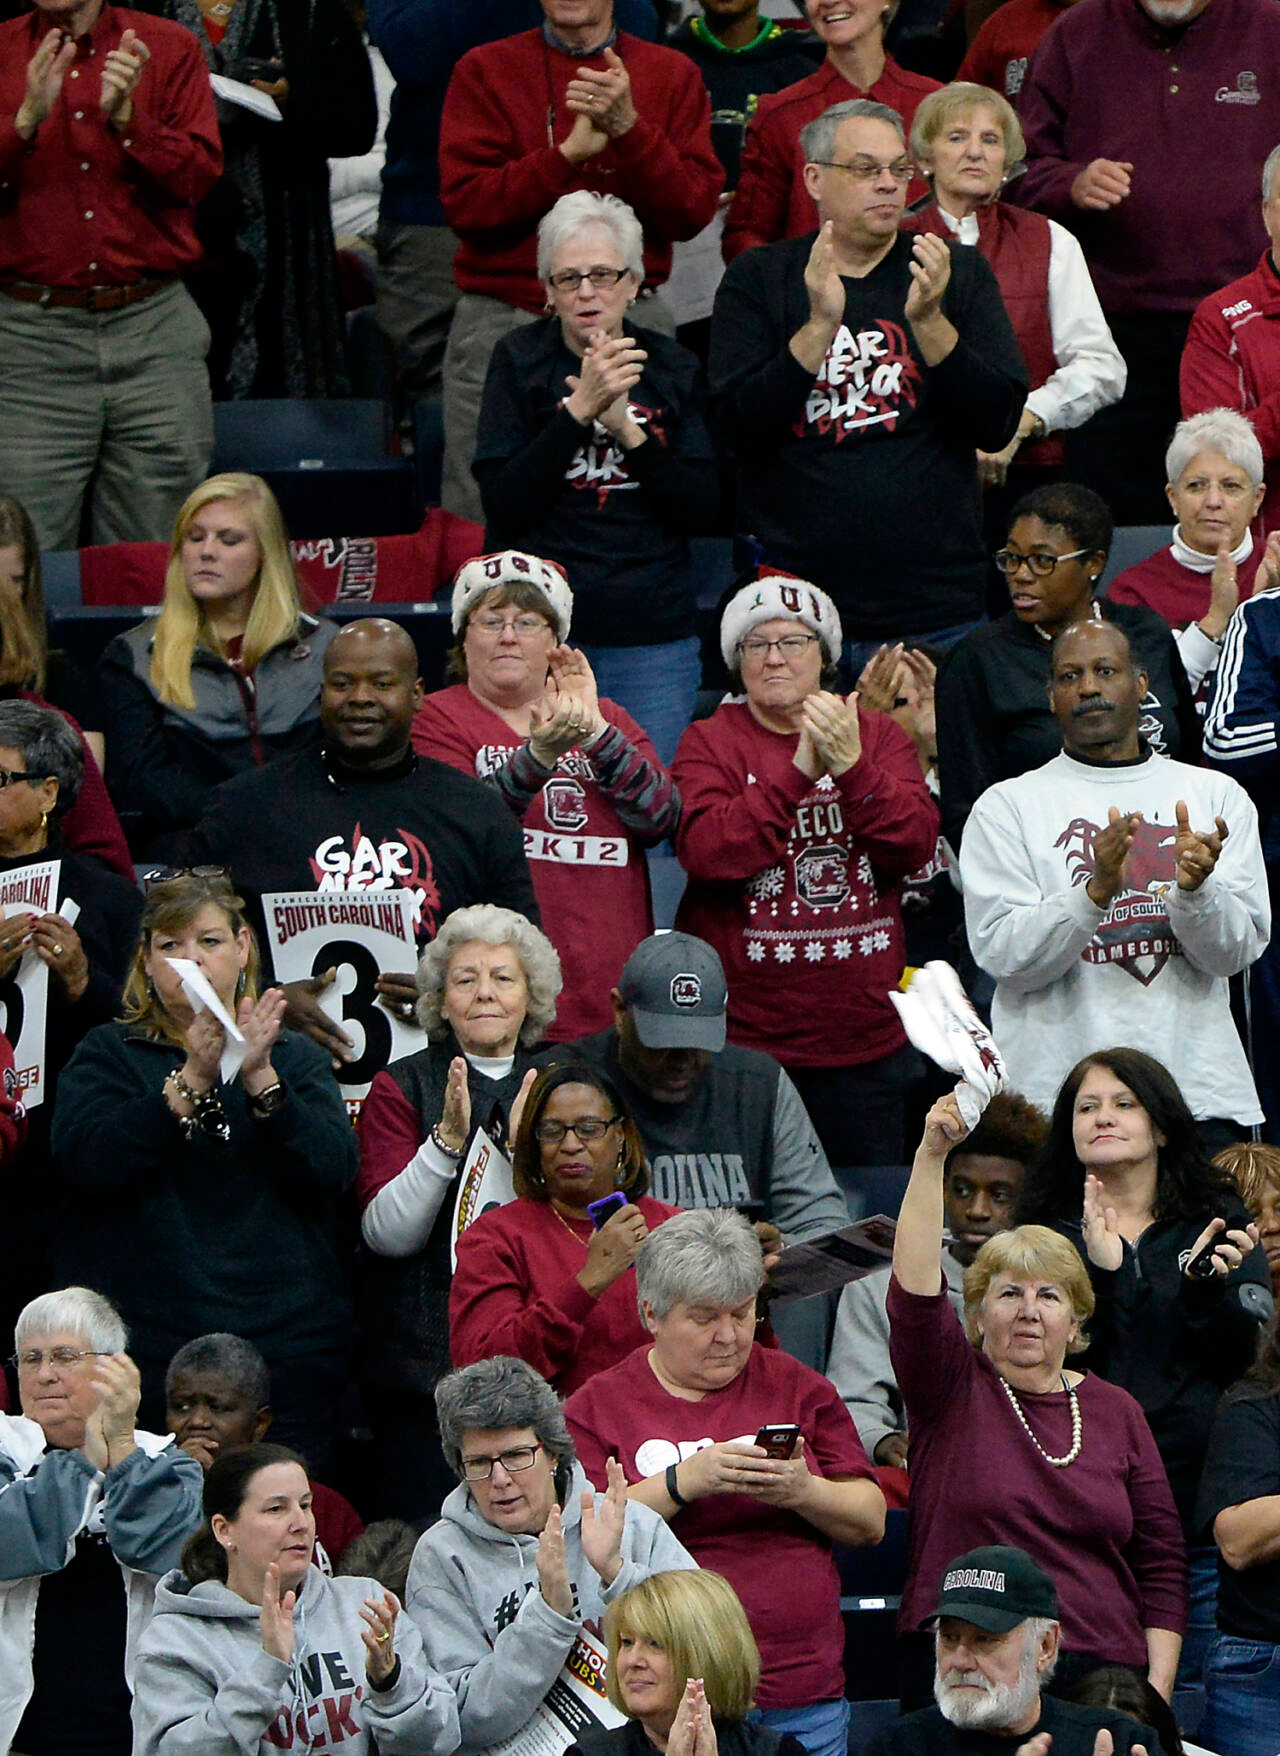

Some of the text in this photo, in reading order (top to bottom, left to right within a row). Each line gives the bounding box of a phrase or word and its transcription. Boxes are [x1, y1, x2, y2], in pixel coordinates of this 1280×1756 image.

[826, 324, 888, 361] AR
[315, 835, 413, 879] GAR
[523, 834, 620, 862] 2K12
[0, 874, 52, 912] AROLINA
[273, 903, 327, 945] SOUTH
[328, 902, 407, 943] CAROLINA
[310, 939, 392, 1086] 3
[652, 1152, 752, 1208] OLINA
[943, 1568, 1006, 1593] CAROLINA
